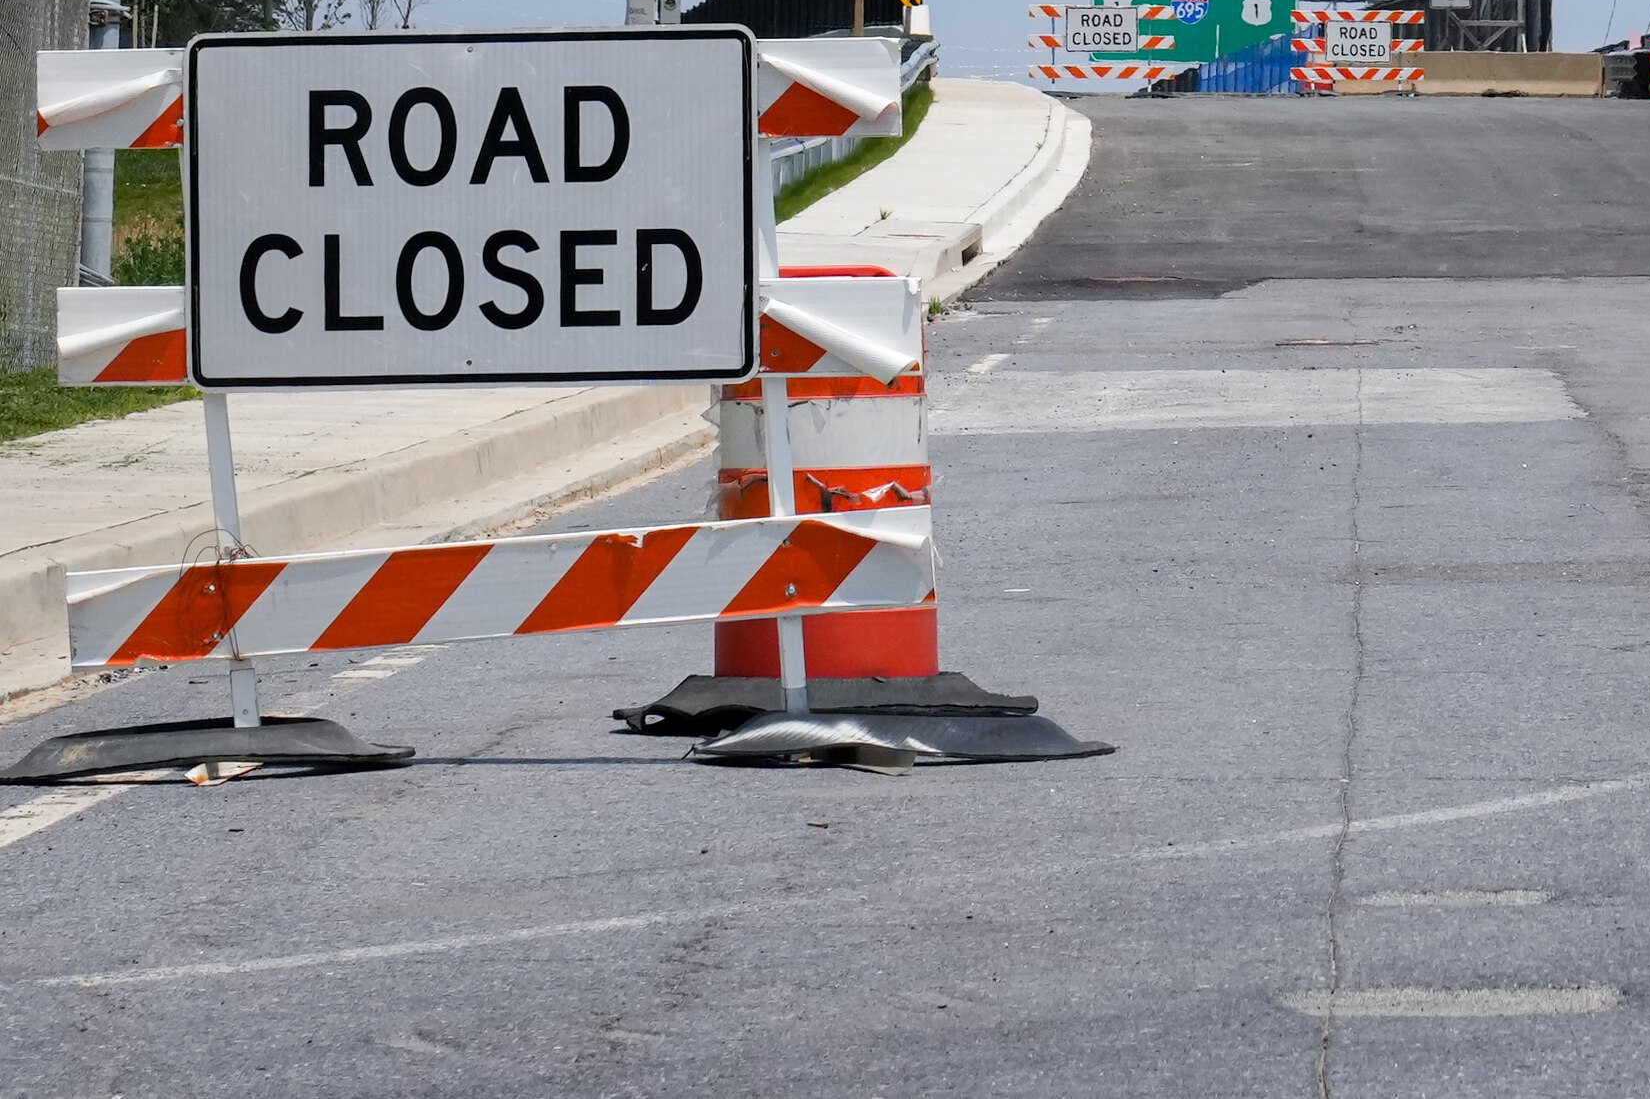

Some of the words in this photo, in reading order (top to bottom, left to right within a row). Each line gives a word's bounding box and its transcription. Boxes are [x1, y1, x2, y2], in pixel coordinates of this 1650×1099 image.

[1176, 1, 1204, 19] 695
[1253, 3, 1259, 18] 1
[1081, 14, 1123, 27] ROAD
[1072, 32, 1132, 45] CLOSED
[1339, 26, 1378, 39] ROAD
[1331, 44, 1386, 57] CLOSED
[308, 85, 630, 187] ROAD
[239, 228, 703, 334] CLOSED
